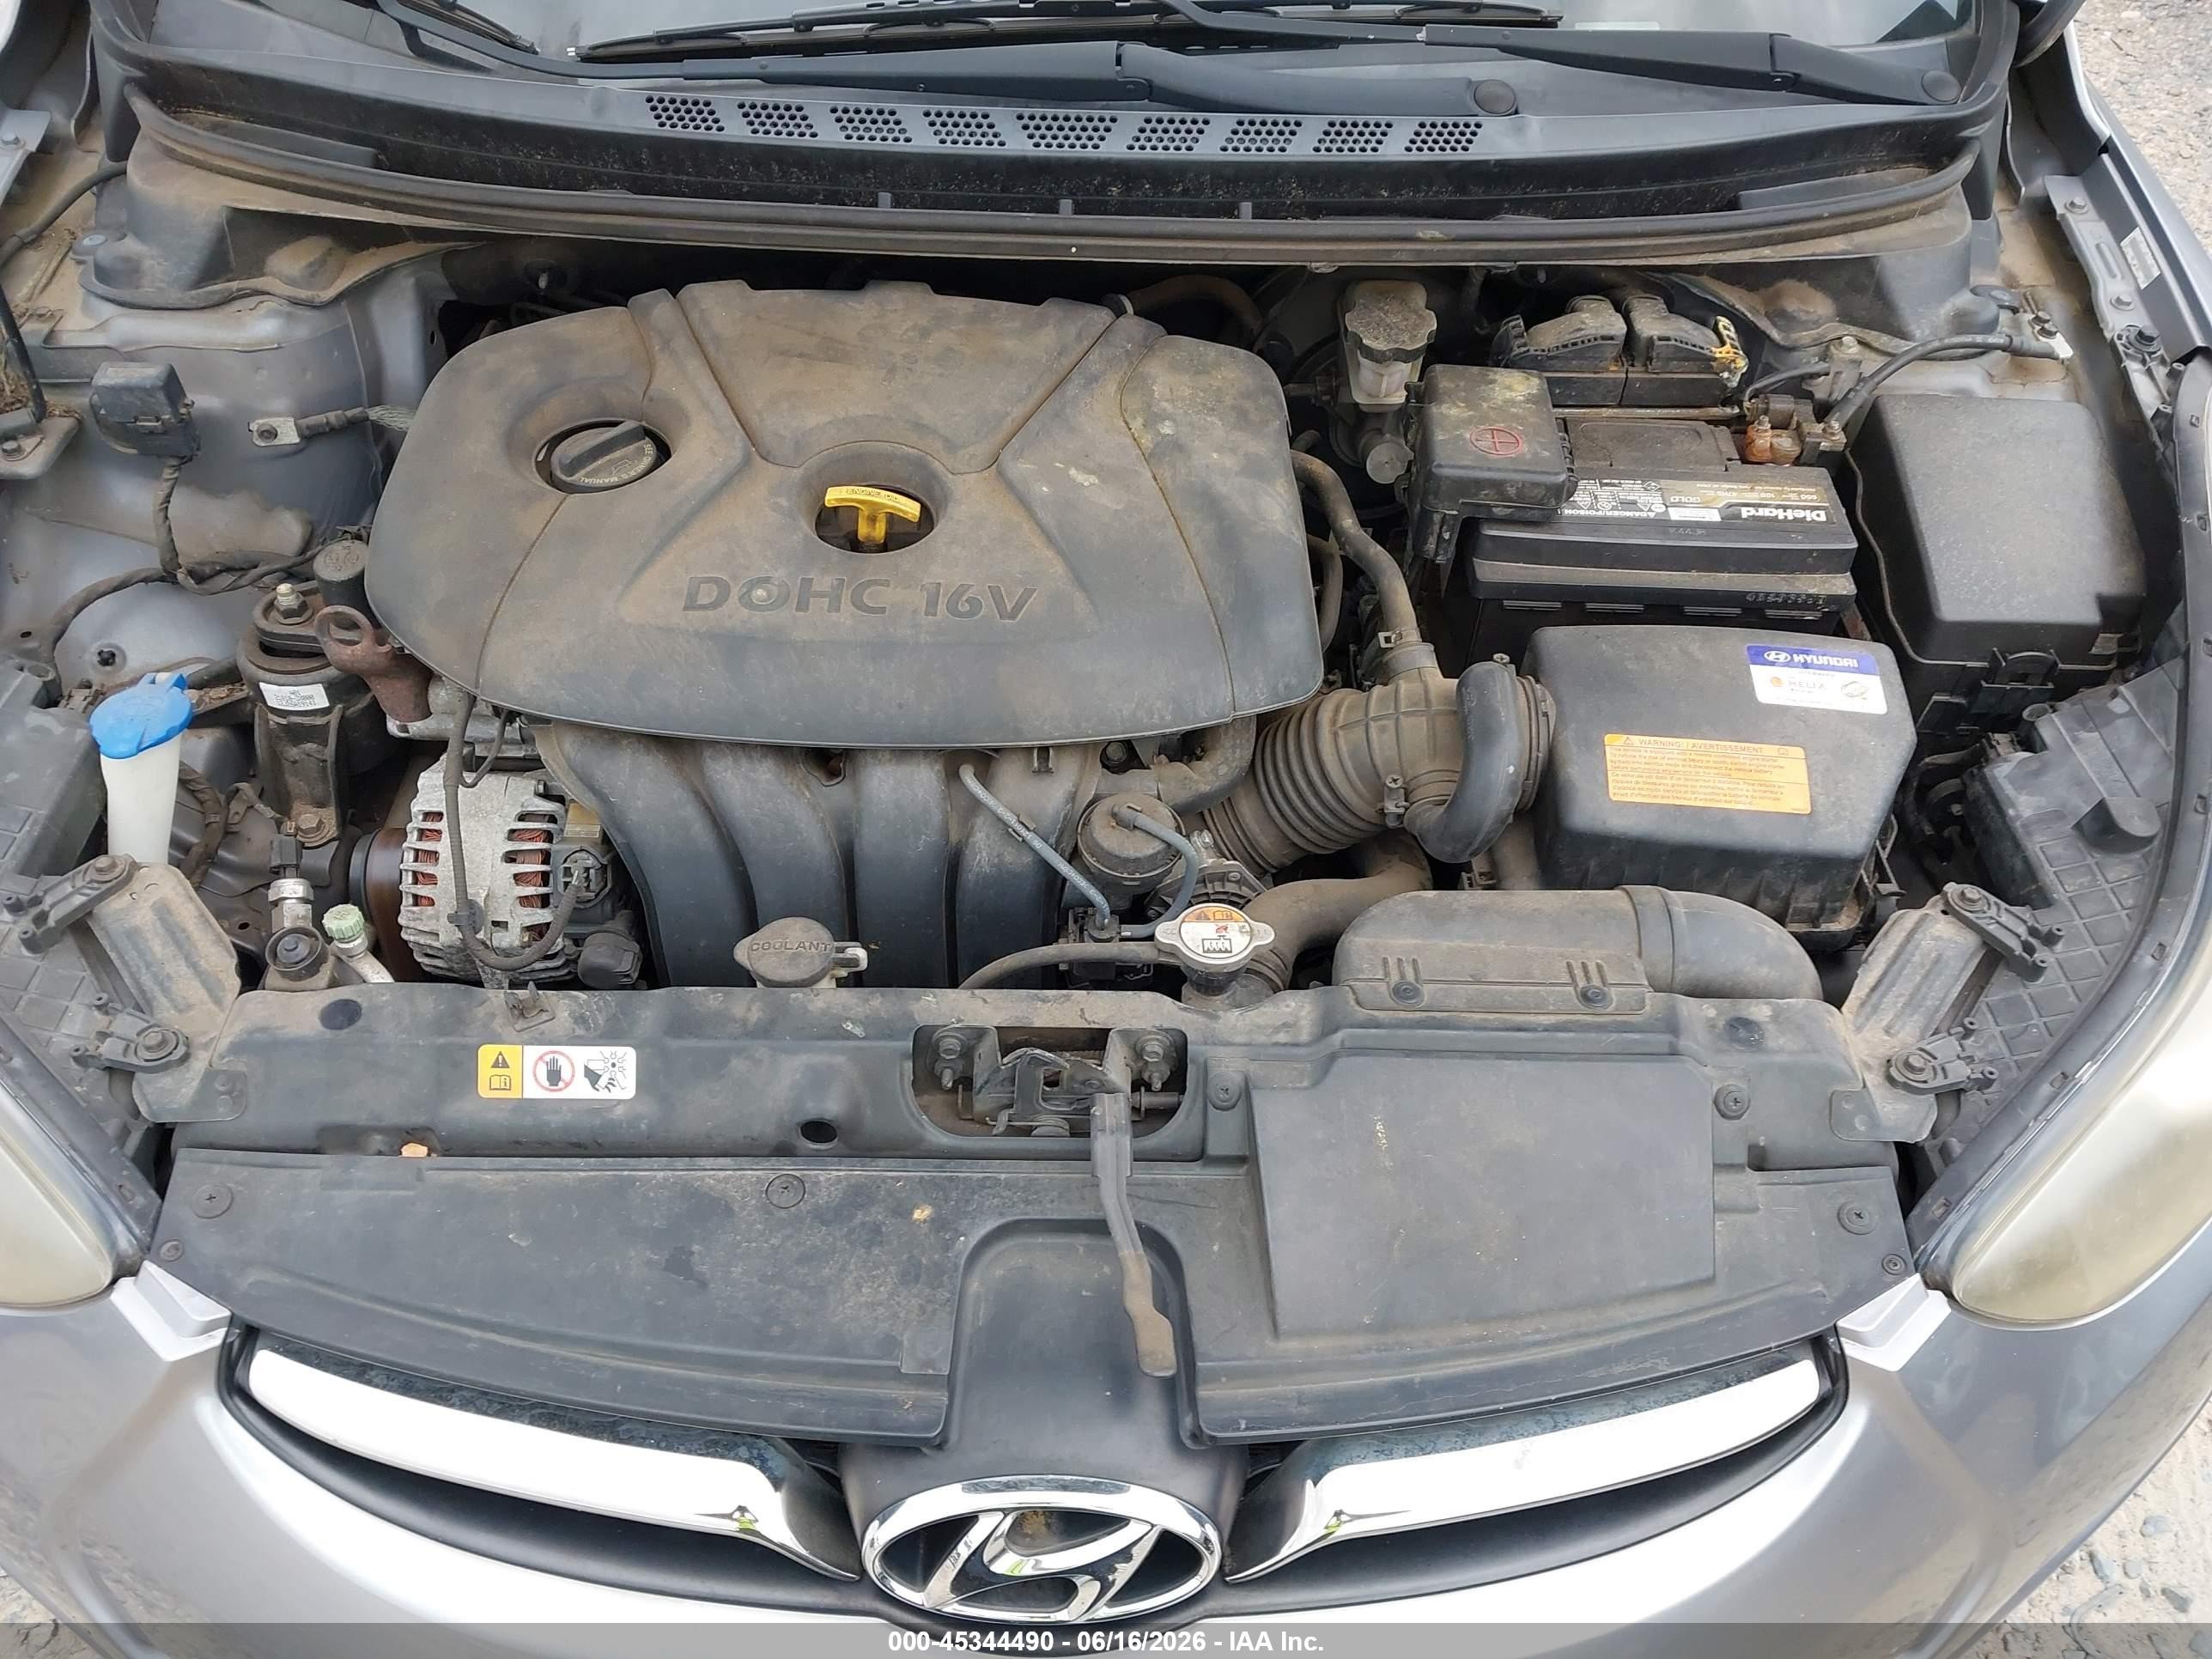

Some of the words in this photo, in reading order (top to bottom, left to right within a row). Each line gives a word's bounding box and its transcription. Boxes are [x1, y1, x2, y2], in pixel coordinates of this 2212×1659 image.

[846, 488, 880, 496] ENGINE
[884, 494, 900, 502] OIL
[1741, 507, 1827, 522] DieHard
[682, 575, 891, 616] DOHC
[919, 580, 1038, 623] 16V
[1793, 653, 1858, 668] HYUNDAI
[1638, 739, 1684, 749] WARNING:
[1691, 743, 1764, 754] AVERTISSEMENT
[750, 939, 832, 952] COOLANT
